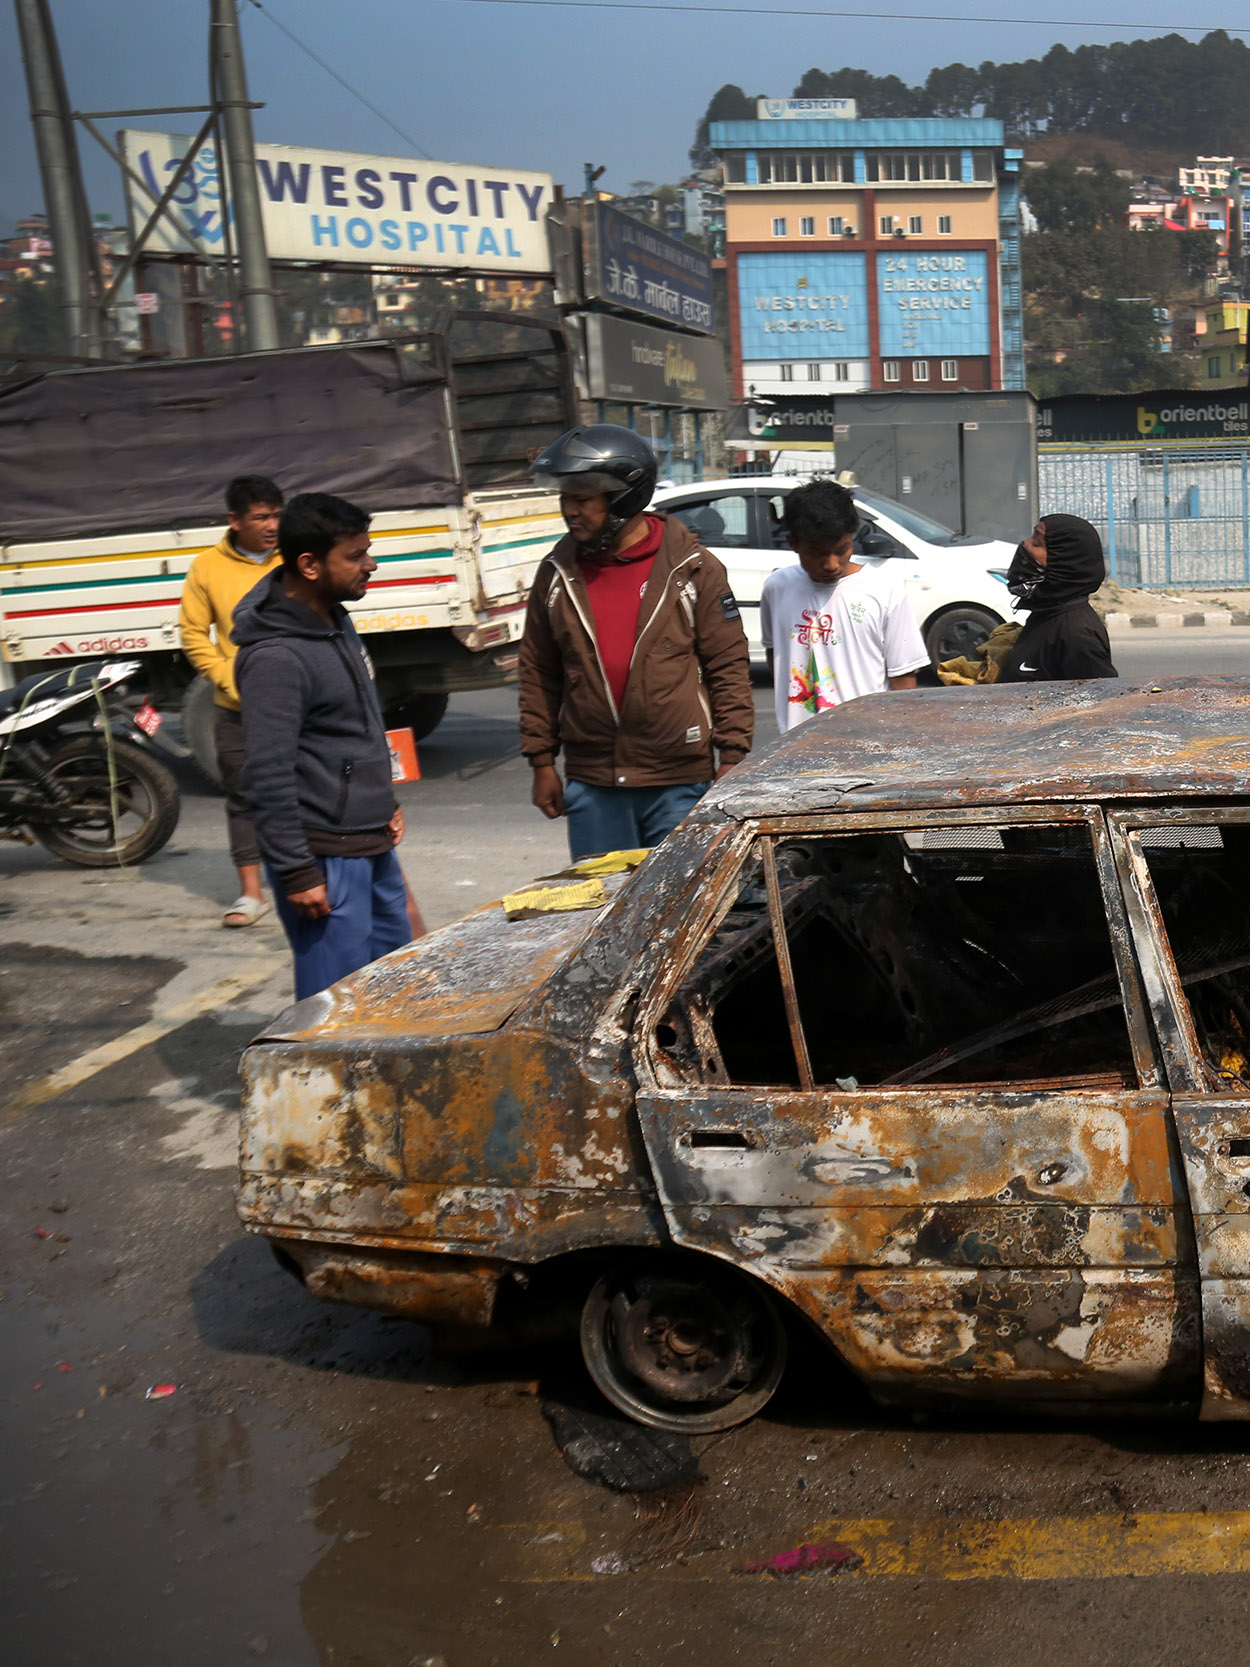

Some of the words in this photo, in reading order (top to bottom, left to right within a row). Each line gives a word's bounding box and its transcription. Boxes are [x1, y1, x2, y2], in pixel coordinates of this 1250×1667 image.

[786, 100, 847, 110] WESTCITY
[256, 159, 545, 222] WESTCITY
[310, 215, 522, 257] HOSPITAL
[885, 257, 907, 272] 24
[917, 256, 966, 272] HOUR
[883, 276, 984, 292] EMERGENCY
[754, 295, 851, 311] WESTCITY
[899, 296, 972, 310] SERVICE
[764, 318, 847, 333] HOSPITAL
[1160, 403, 1249, 422] orientbell
[1223, 420, 1249, 431] tiles
[354, 613, 429, 631] adidas
[77, 636, 149, 653] adidas
